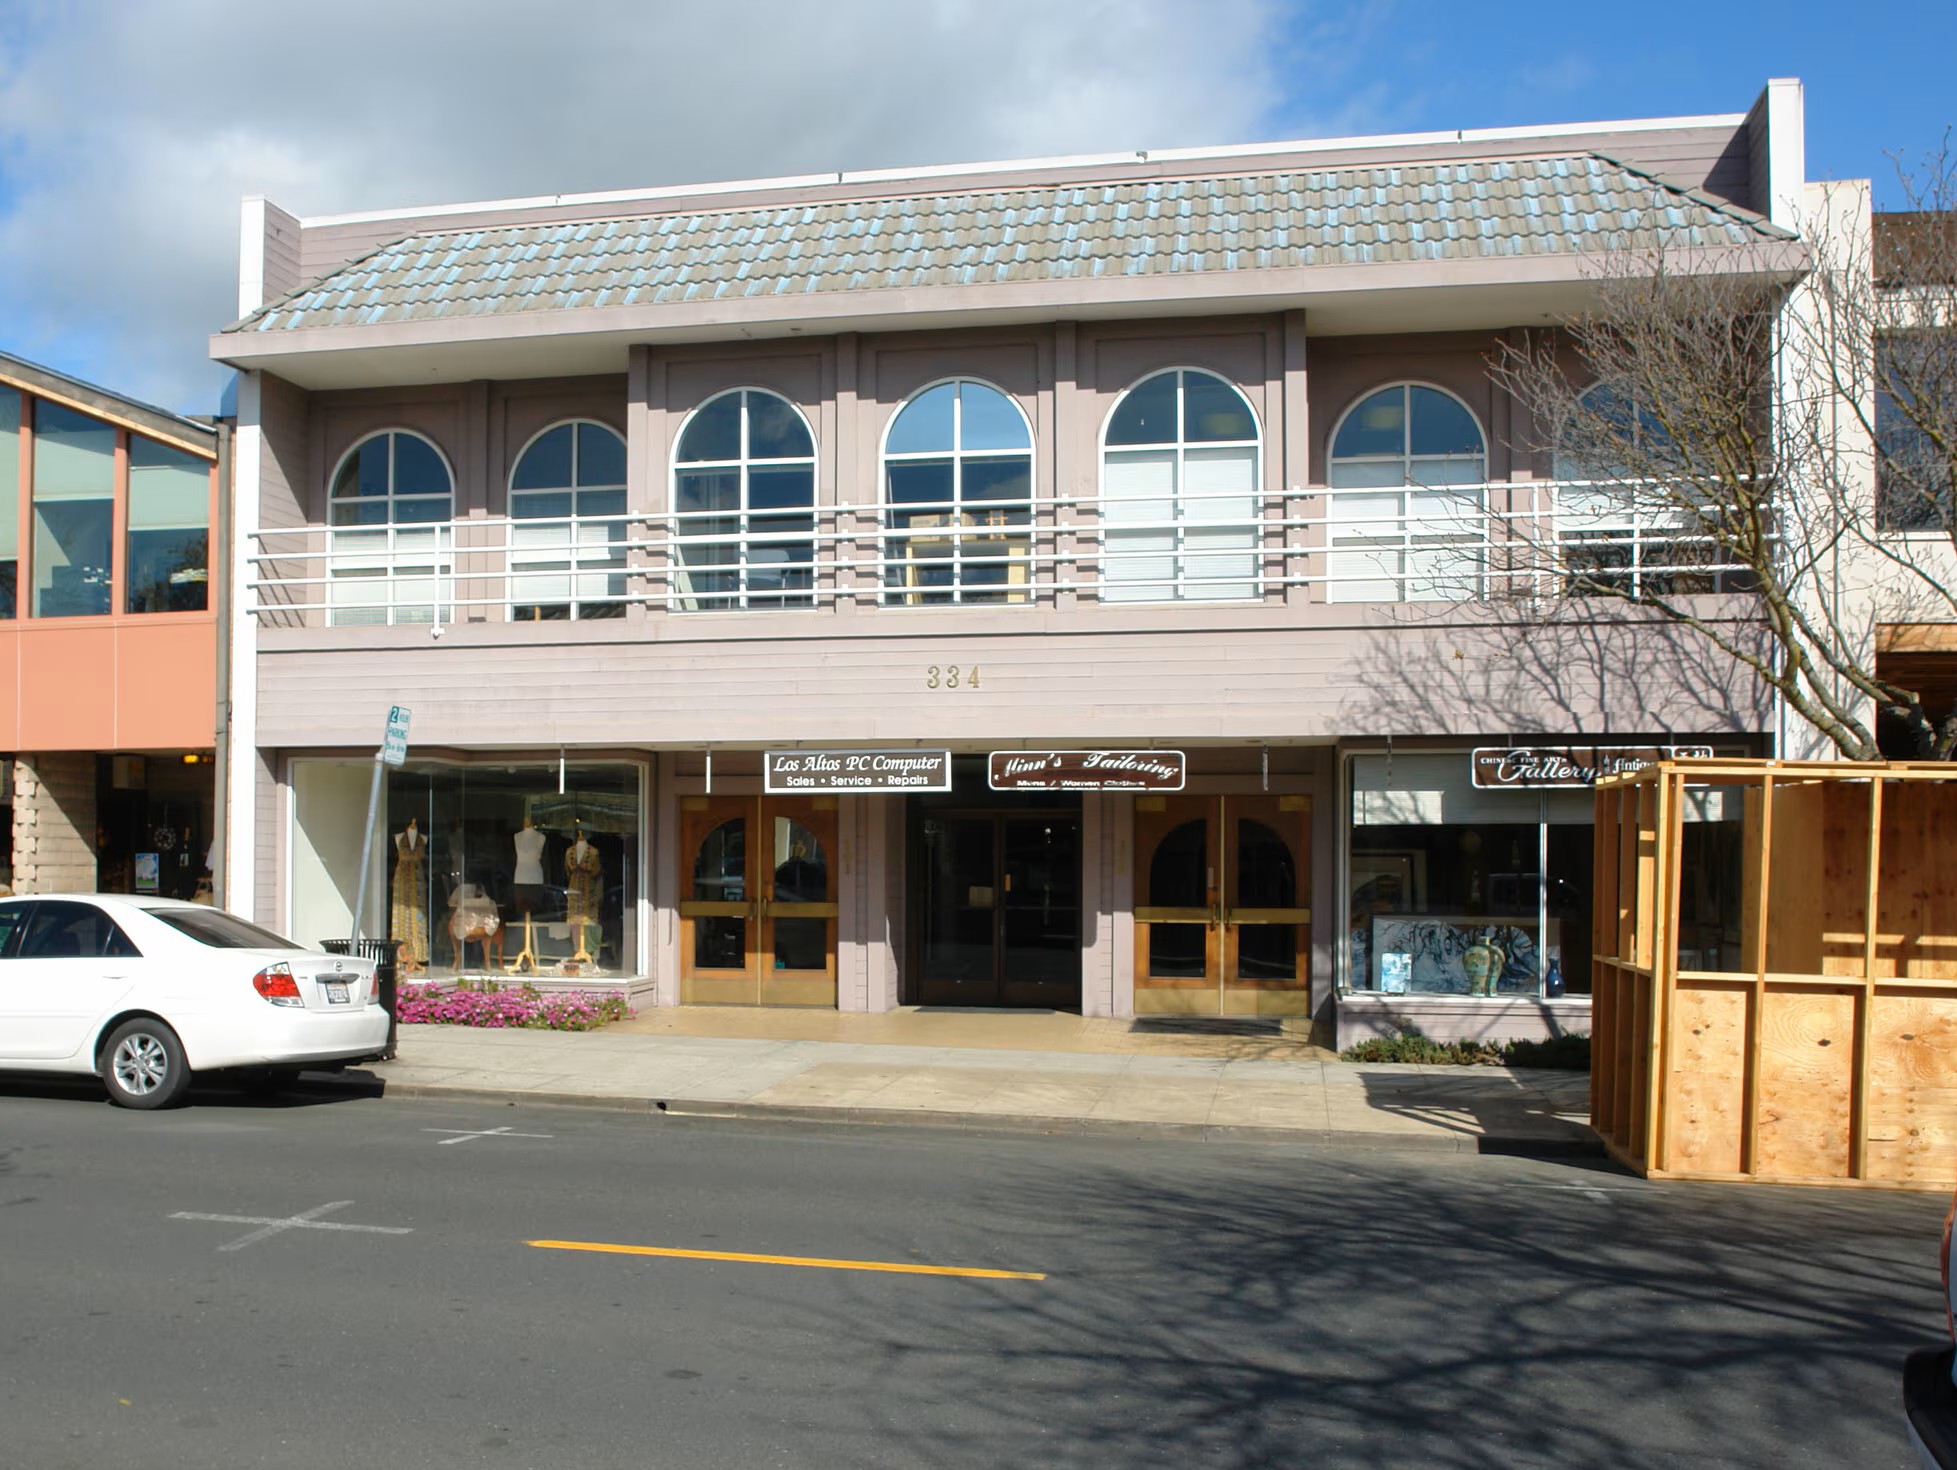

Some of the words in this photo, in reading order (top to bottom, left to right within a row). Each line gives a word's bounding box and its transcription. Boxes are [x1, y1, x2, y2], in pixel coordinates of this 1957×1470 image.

[927, 665, 980, 689] 334
[391, 707, 398, 722] 2
[773, 756, 799, 772] Los
[802, 754, 841, 772] Altos
[845, 755, 871, 771] PC
[872, 755, 942, 776] Computer
[1082, 752, 1179, 781] Tailoring
[1497, 750, 1600, 784] Gallery
[1520, 756, 1539, 764] FINE
[786, 775, 815, 786] Sales
[830, 775, 872, 786] Service
[887, 774, 929, 786] Repairs
